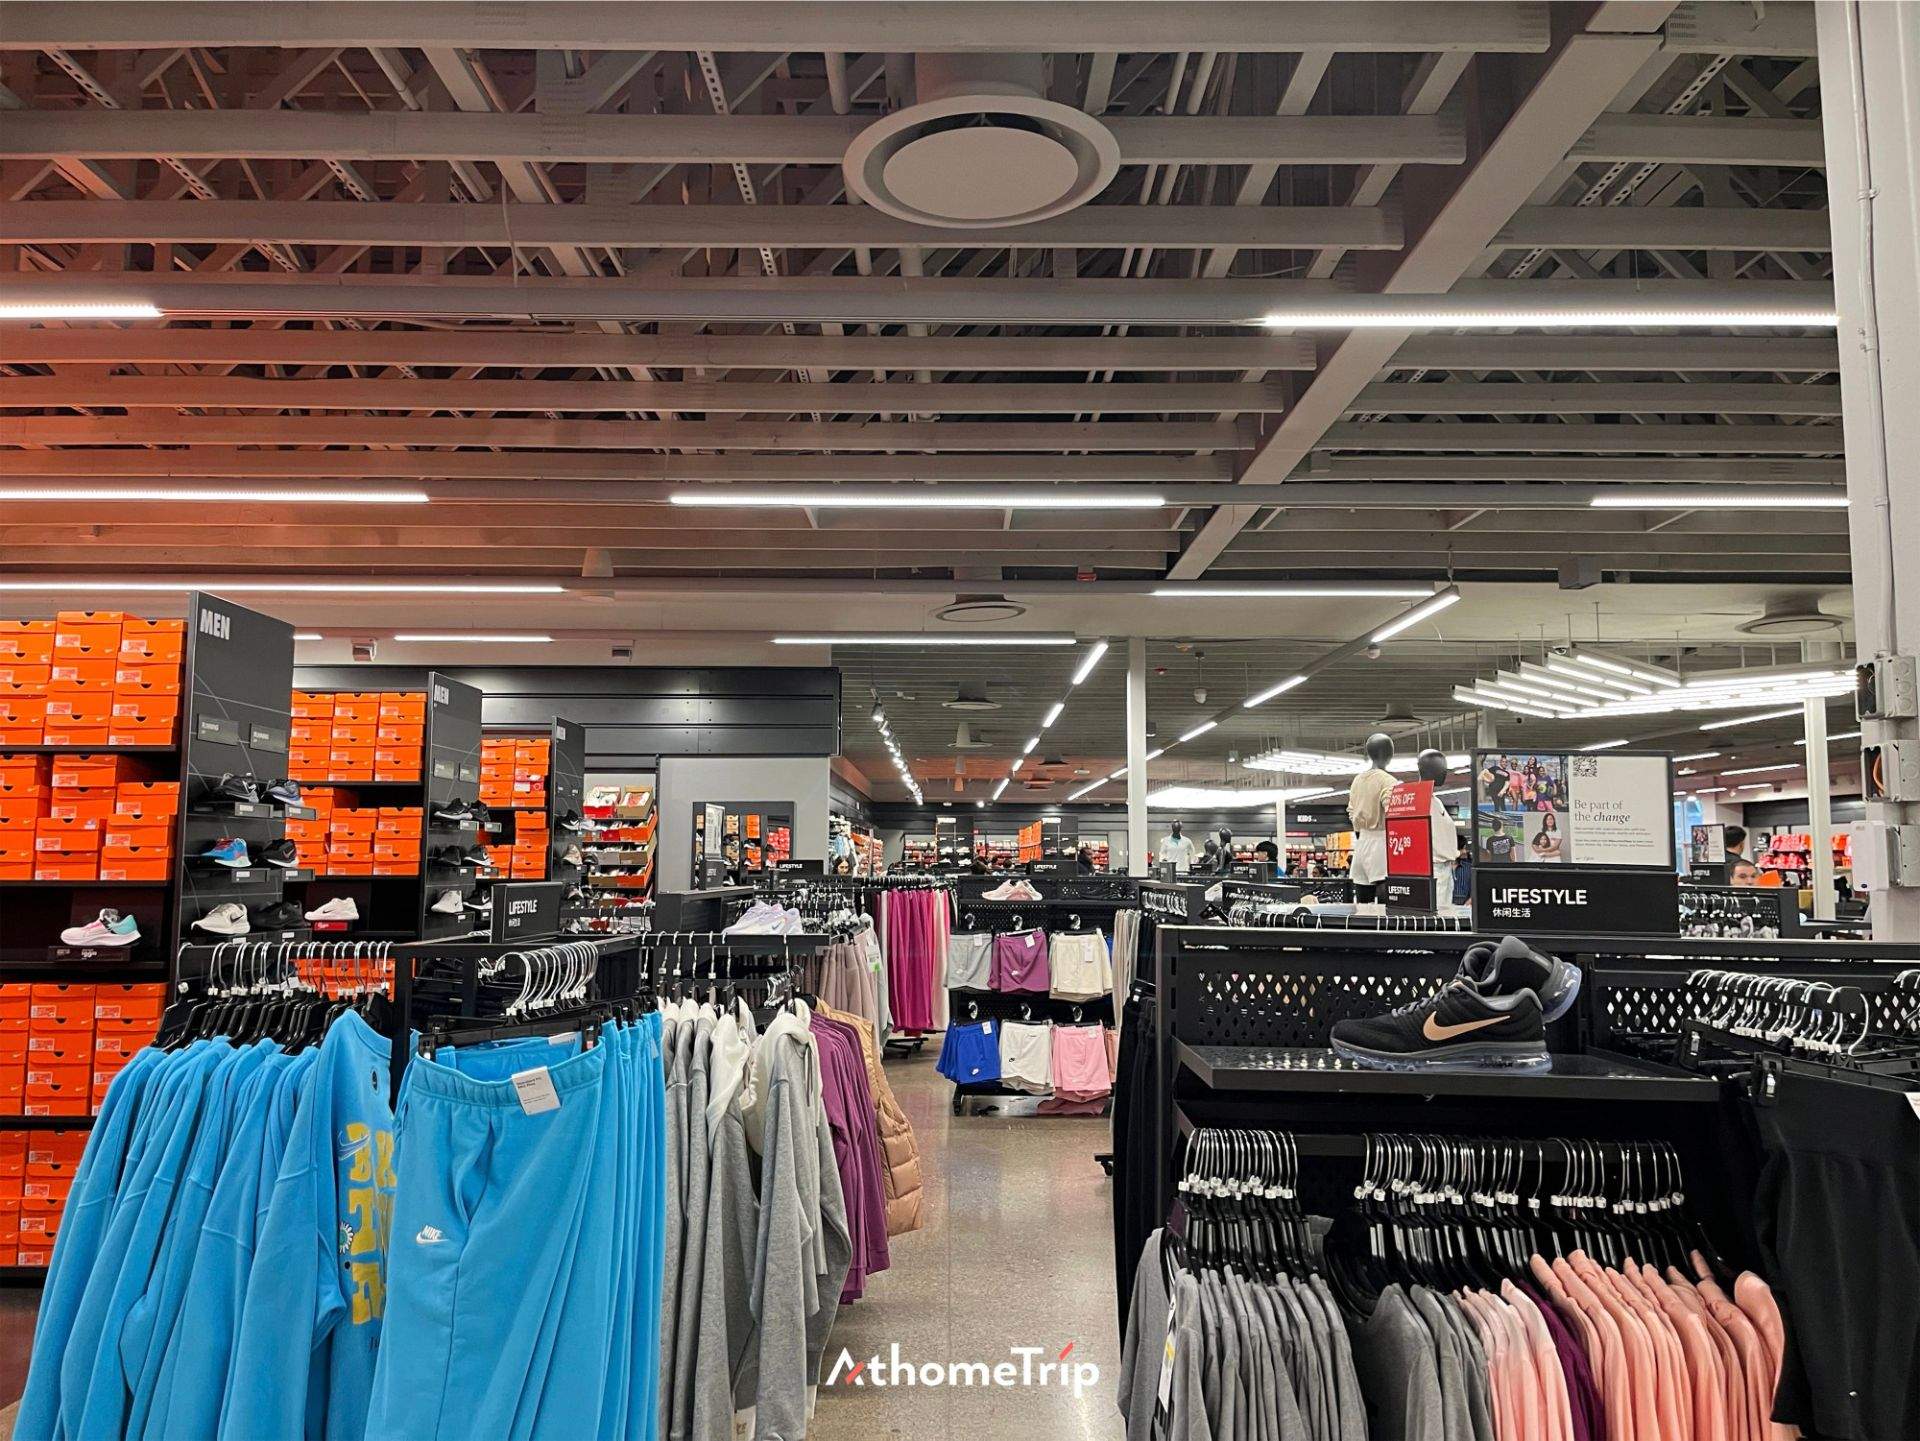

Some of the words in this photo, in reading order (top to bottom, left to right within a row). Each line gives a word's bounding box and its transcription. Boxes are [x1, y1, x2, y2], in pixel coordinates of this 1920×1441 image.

[200, 608, 231, 641] MEN
[1574, 800, 1587, 809] Be
[1590, 800, 1610, 811] part
[1612, 799, 1624, 809] of
[1297, 814, 1312, 823] KIDS
[1574, 812, 1591, 822] the
[1593, 812, 1631, 824] change
[1388, 886, 1411, 895] LIFESTYLE
[1491, 887, 1588, 905] LIFESTYLE
[508, 899, 539, 915] LIFESTYLE
[1492, 907, 1531, 918] 休闲生活
